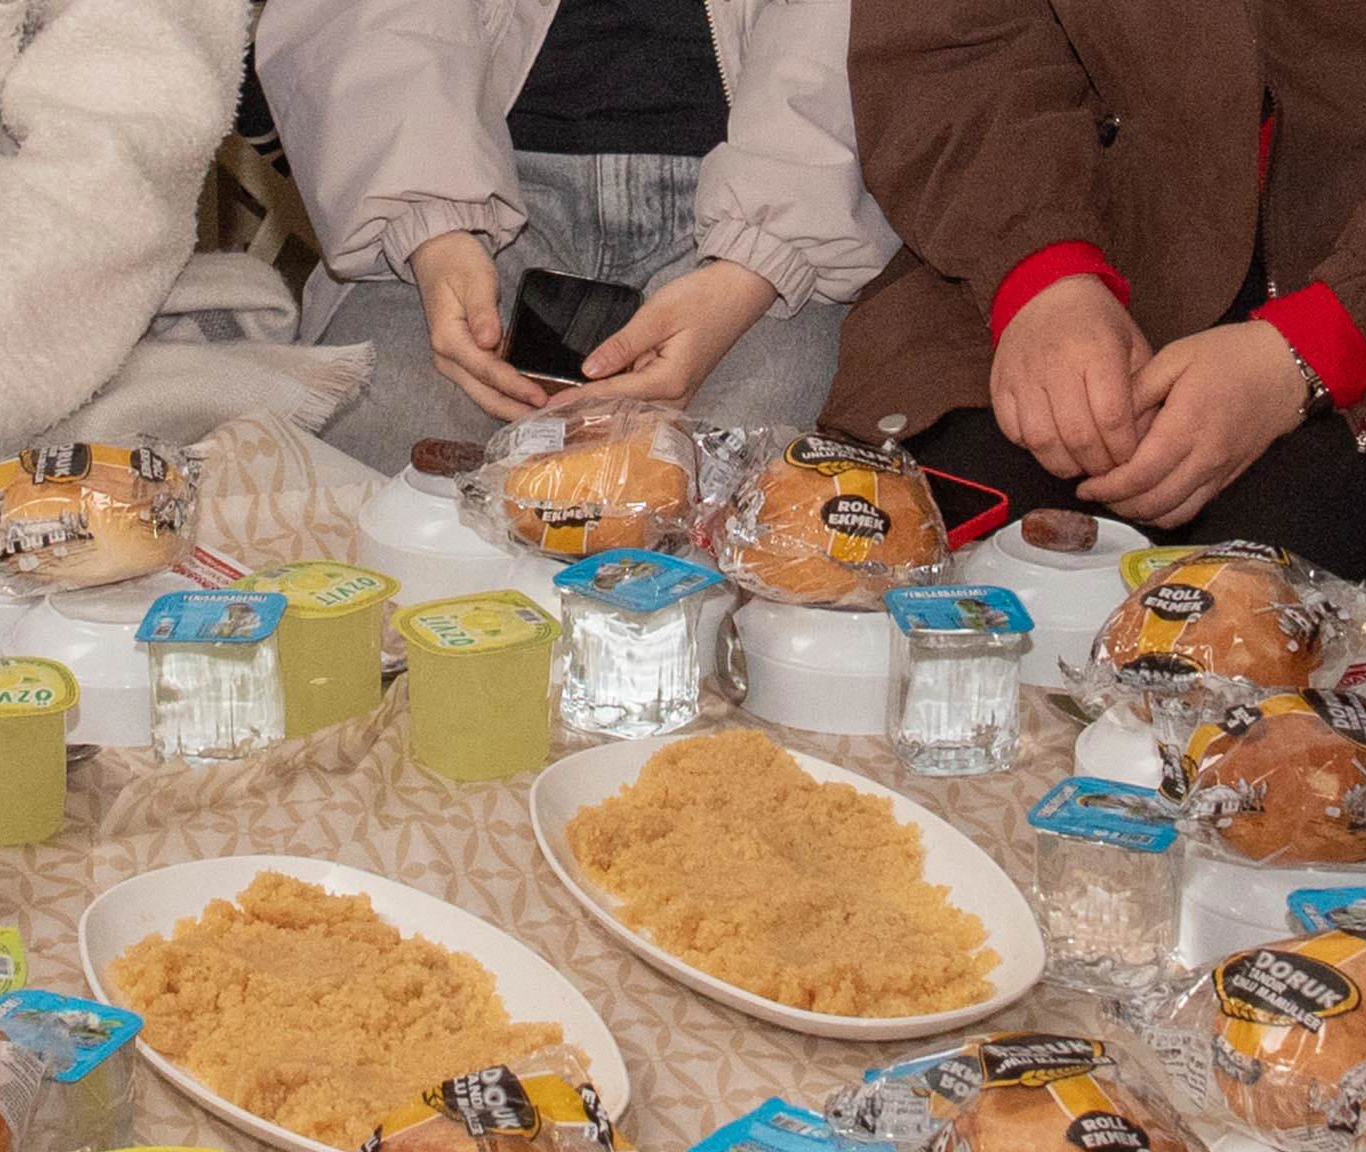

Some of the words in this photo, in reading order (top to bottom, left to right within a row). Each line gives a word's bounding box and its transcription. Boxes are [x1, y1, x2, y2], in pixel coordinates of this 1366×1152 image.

[837, 500, 880, 517] ROLL
[828, 513, 885, 532] EKMEK
[1158, 587, 1202, 601] ROLL
[1144, 596, 1204, 613] EKMEK
[1254, 950, 1344, 1009] DORUK
[1080, 1115, 1128, 1132] ROLL
[1081, 1130, 1143, 1149] EKMEK
